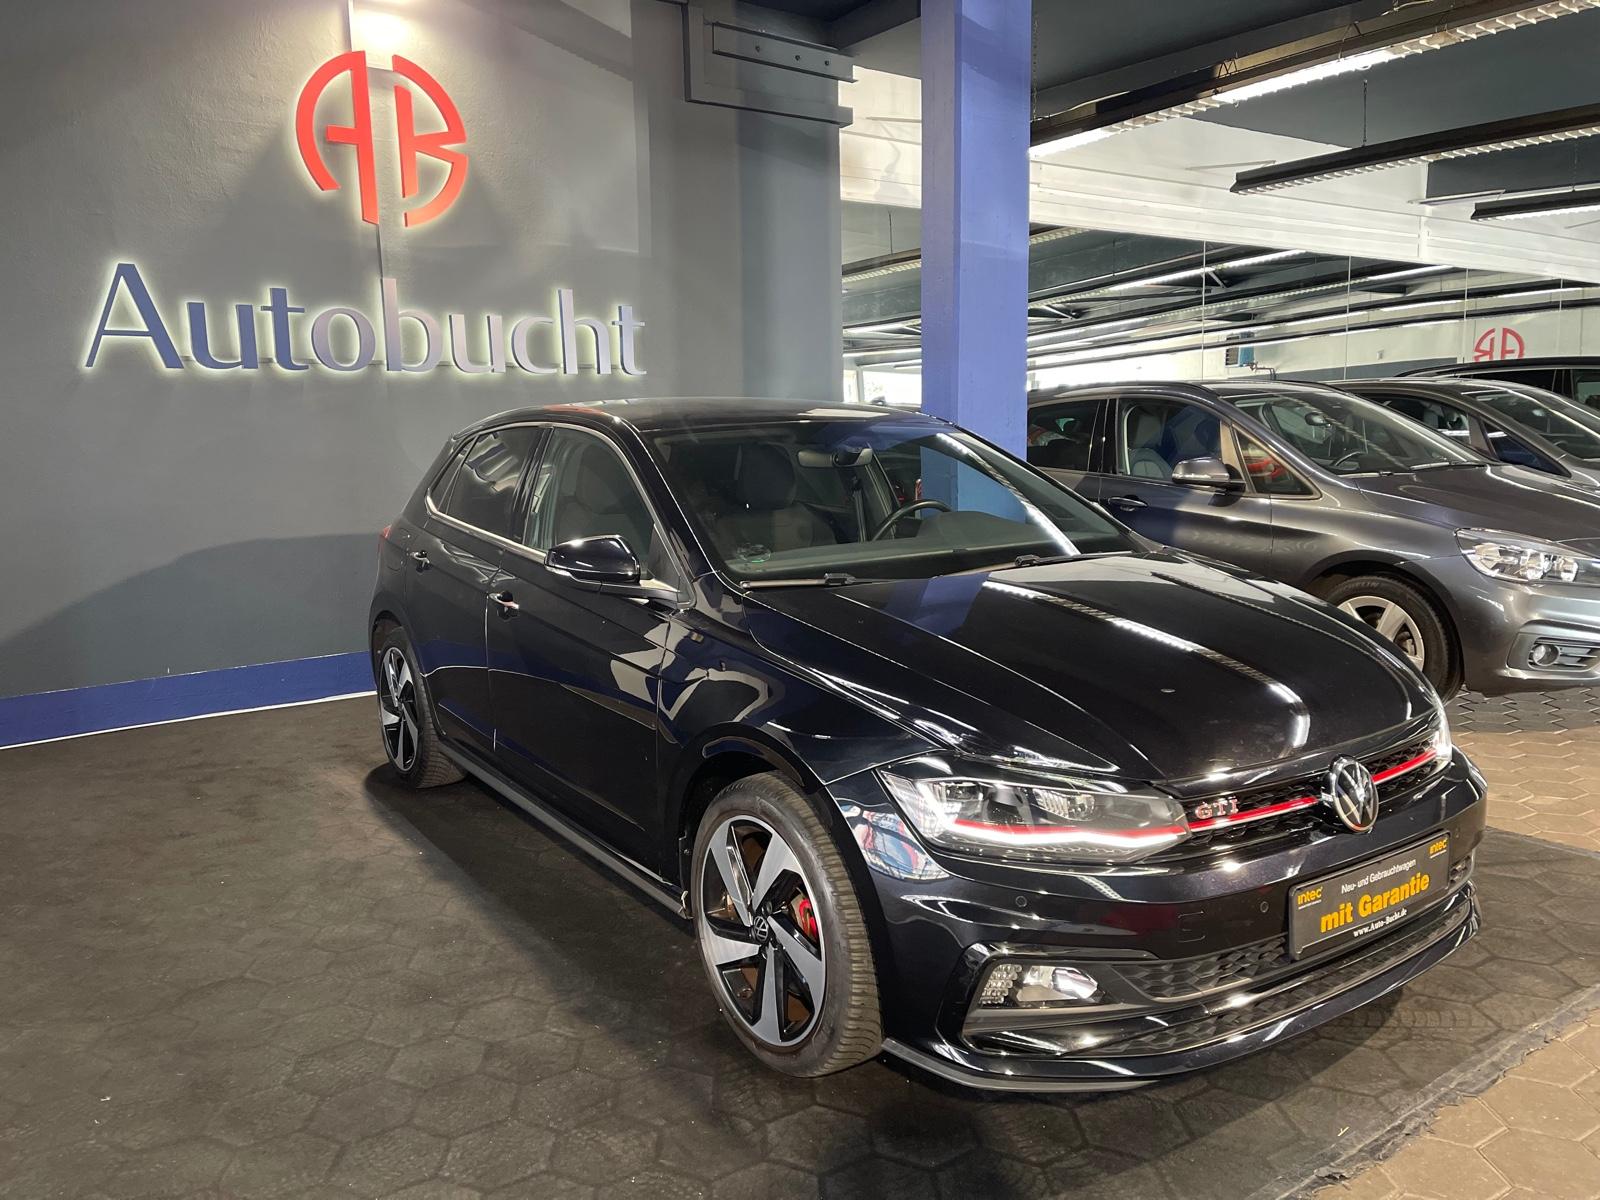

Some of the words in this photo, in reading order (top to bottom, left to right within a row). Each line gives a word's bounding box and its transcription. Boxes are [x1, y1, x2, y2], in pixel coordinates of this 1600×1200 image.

[84, 261, 648, 376] Autobucht
[1195, 796, 1240, 819] GTI
[1341, 883, 1357, 894] Neu-
[1357, 875, 1369, 888] und
[1369, 859, 1417, 883] Gebrauchtwagen
[1297, 887, 1323, 905] intec
[1320, 902, 1354, 933] mit
[1358, 872, 1430, 918] Garantie
